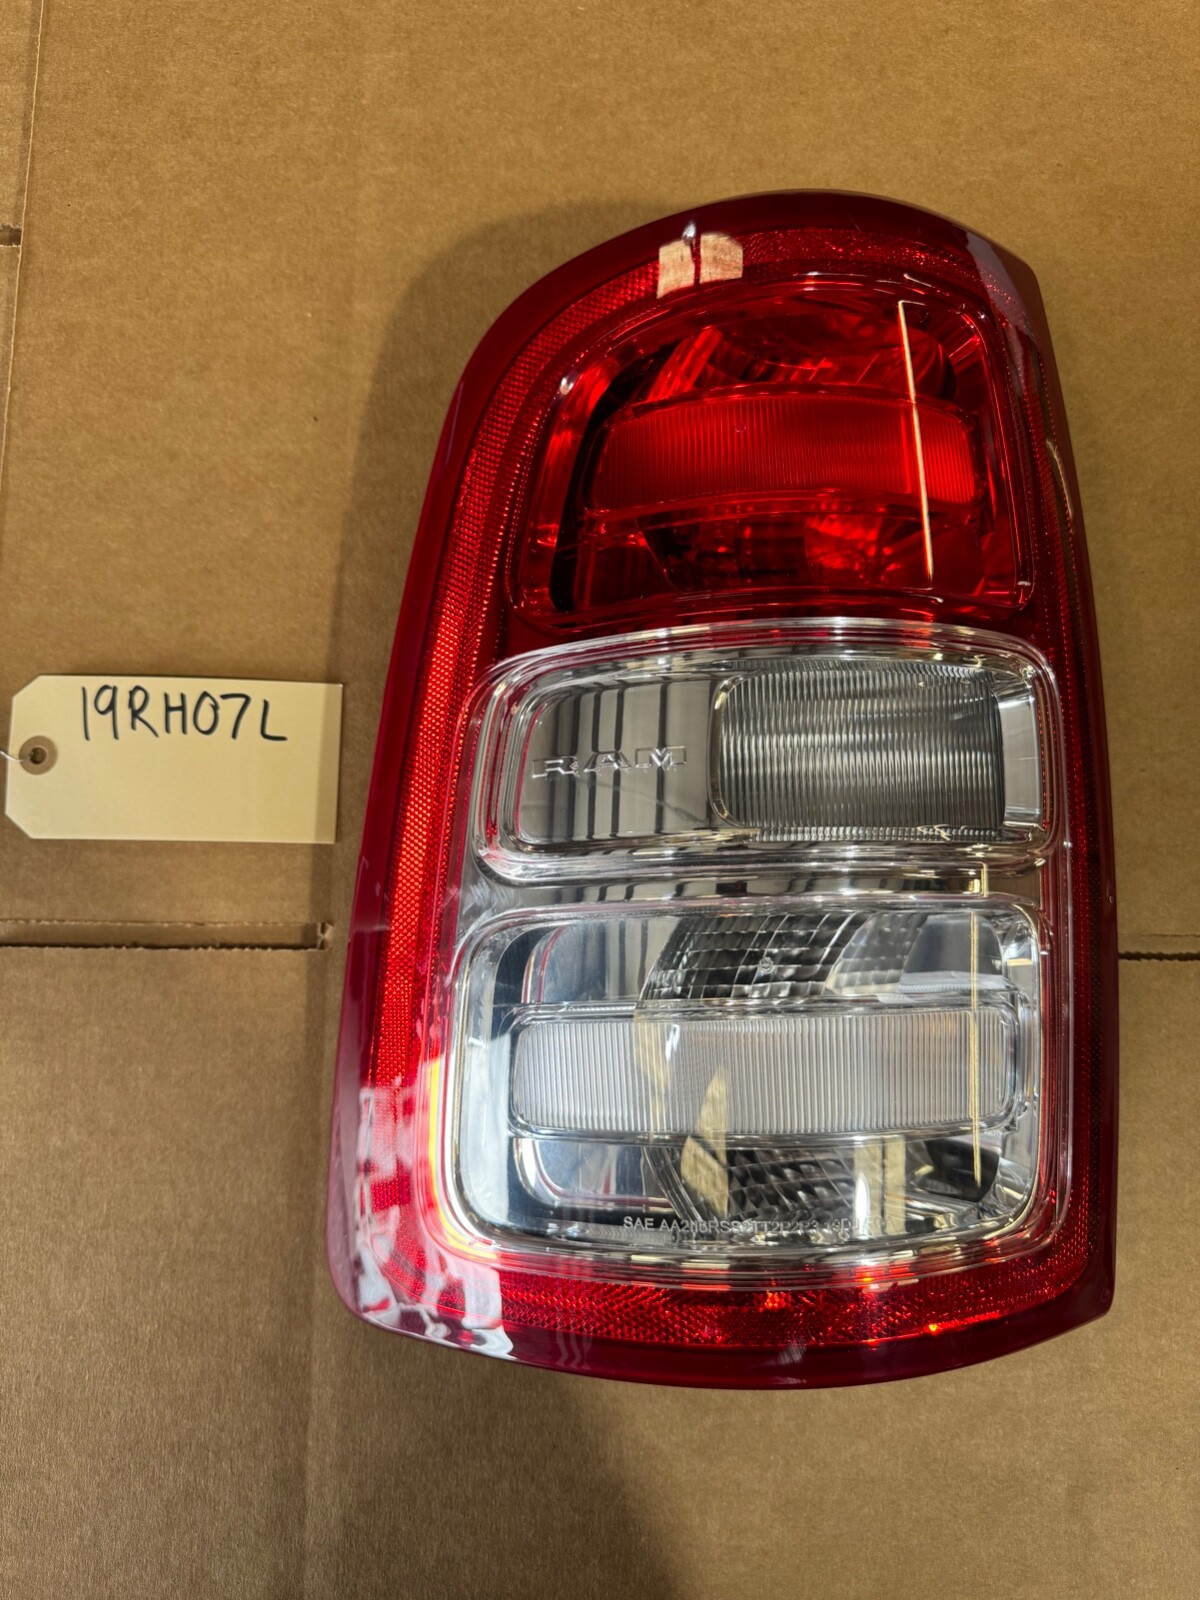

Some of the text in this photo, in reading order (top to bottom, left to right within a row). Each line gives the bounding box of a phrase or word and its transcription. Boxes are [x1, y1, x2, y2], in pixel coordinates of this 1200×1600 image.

[82, 684, 288, 741] 19RH07L
[532, 745, 687, 779] RAM
[623, 1215, 655, 1231] SAE
